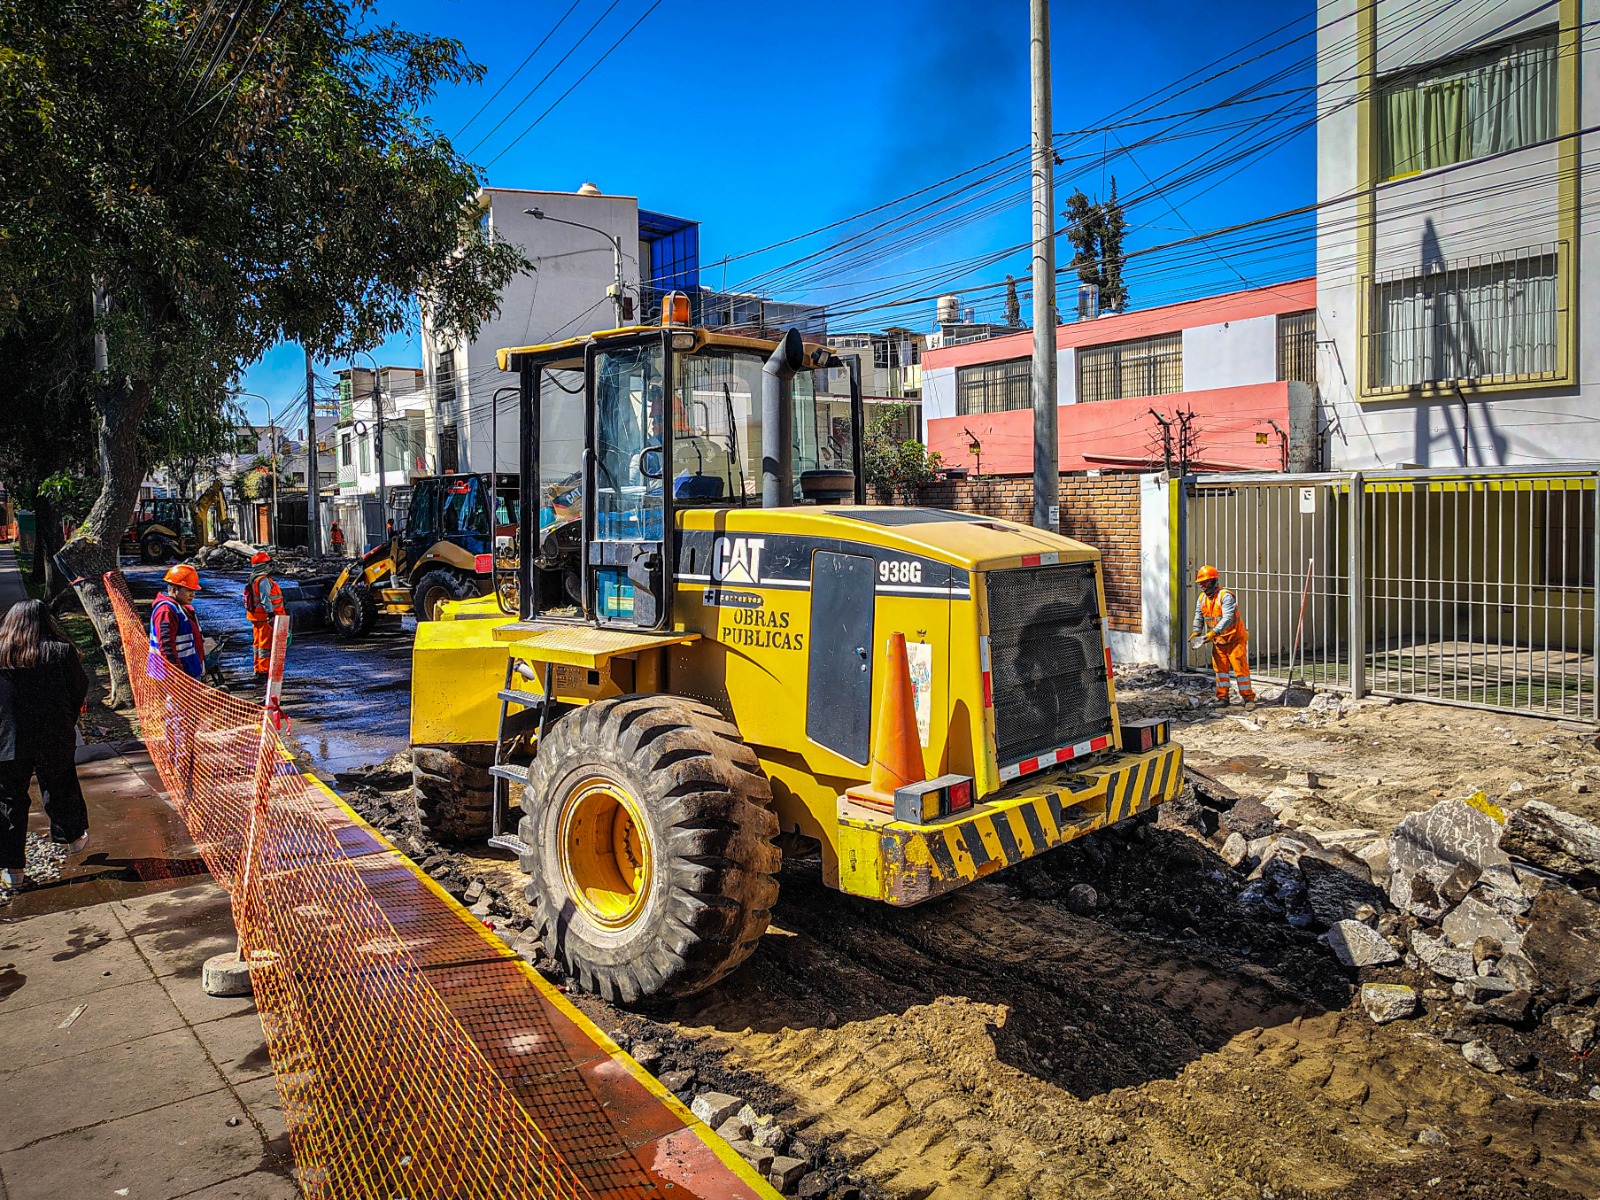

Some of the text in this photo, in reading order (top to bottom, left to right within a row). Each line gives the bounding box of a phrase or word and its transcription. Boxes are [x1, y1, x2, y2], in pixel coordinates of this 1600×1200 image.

[565, 487, 583, 504] CAT
[712, 536, 765, 584] CAT
[879, 560, 922, 584] 938G
[733, 608, 790, 629] OBRAS
[721, 626, 804, 651] PUBLICAS
